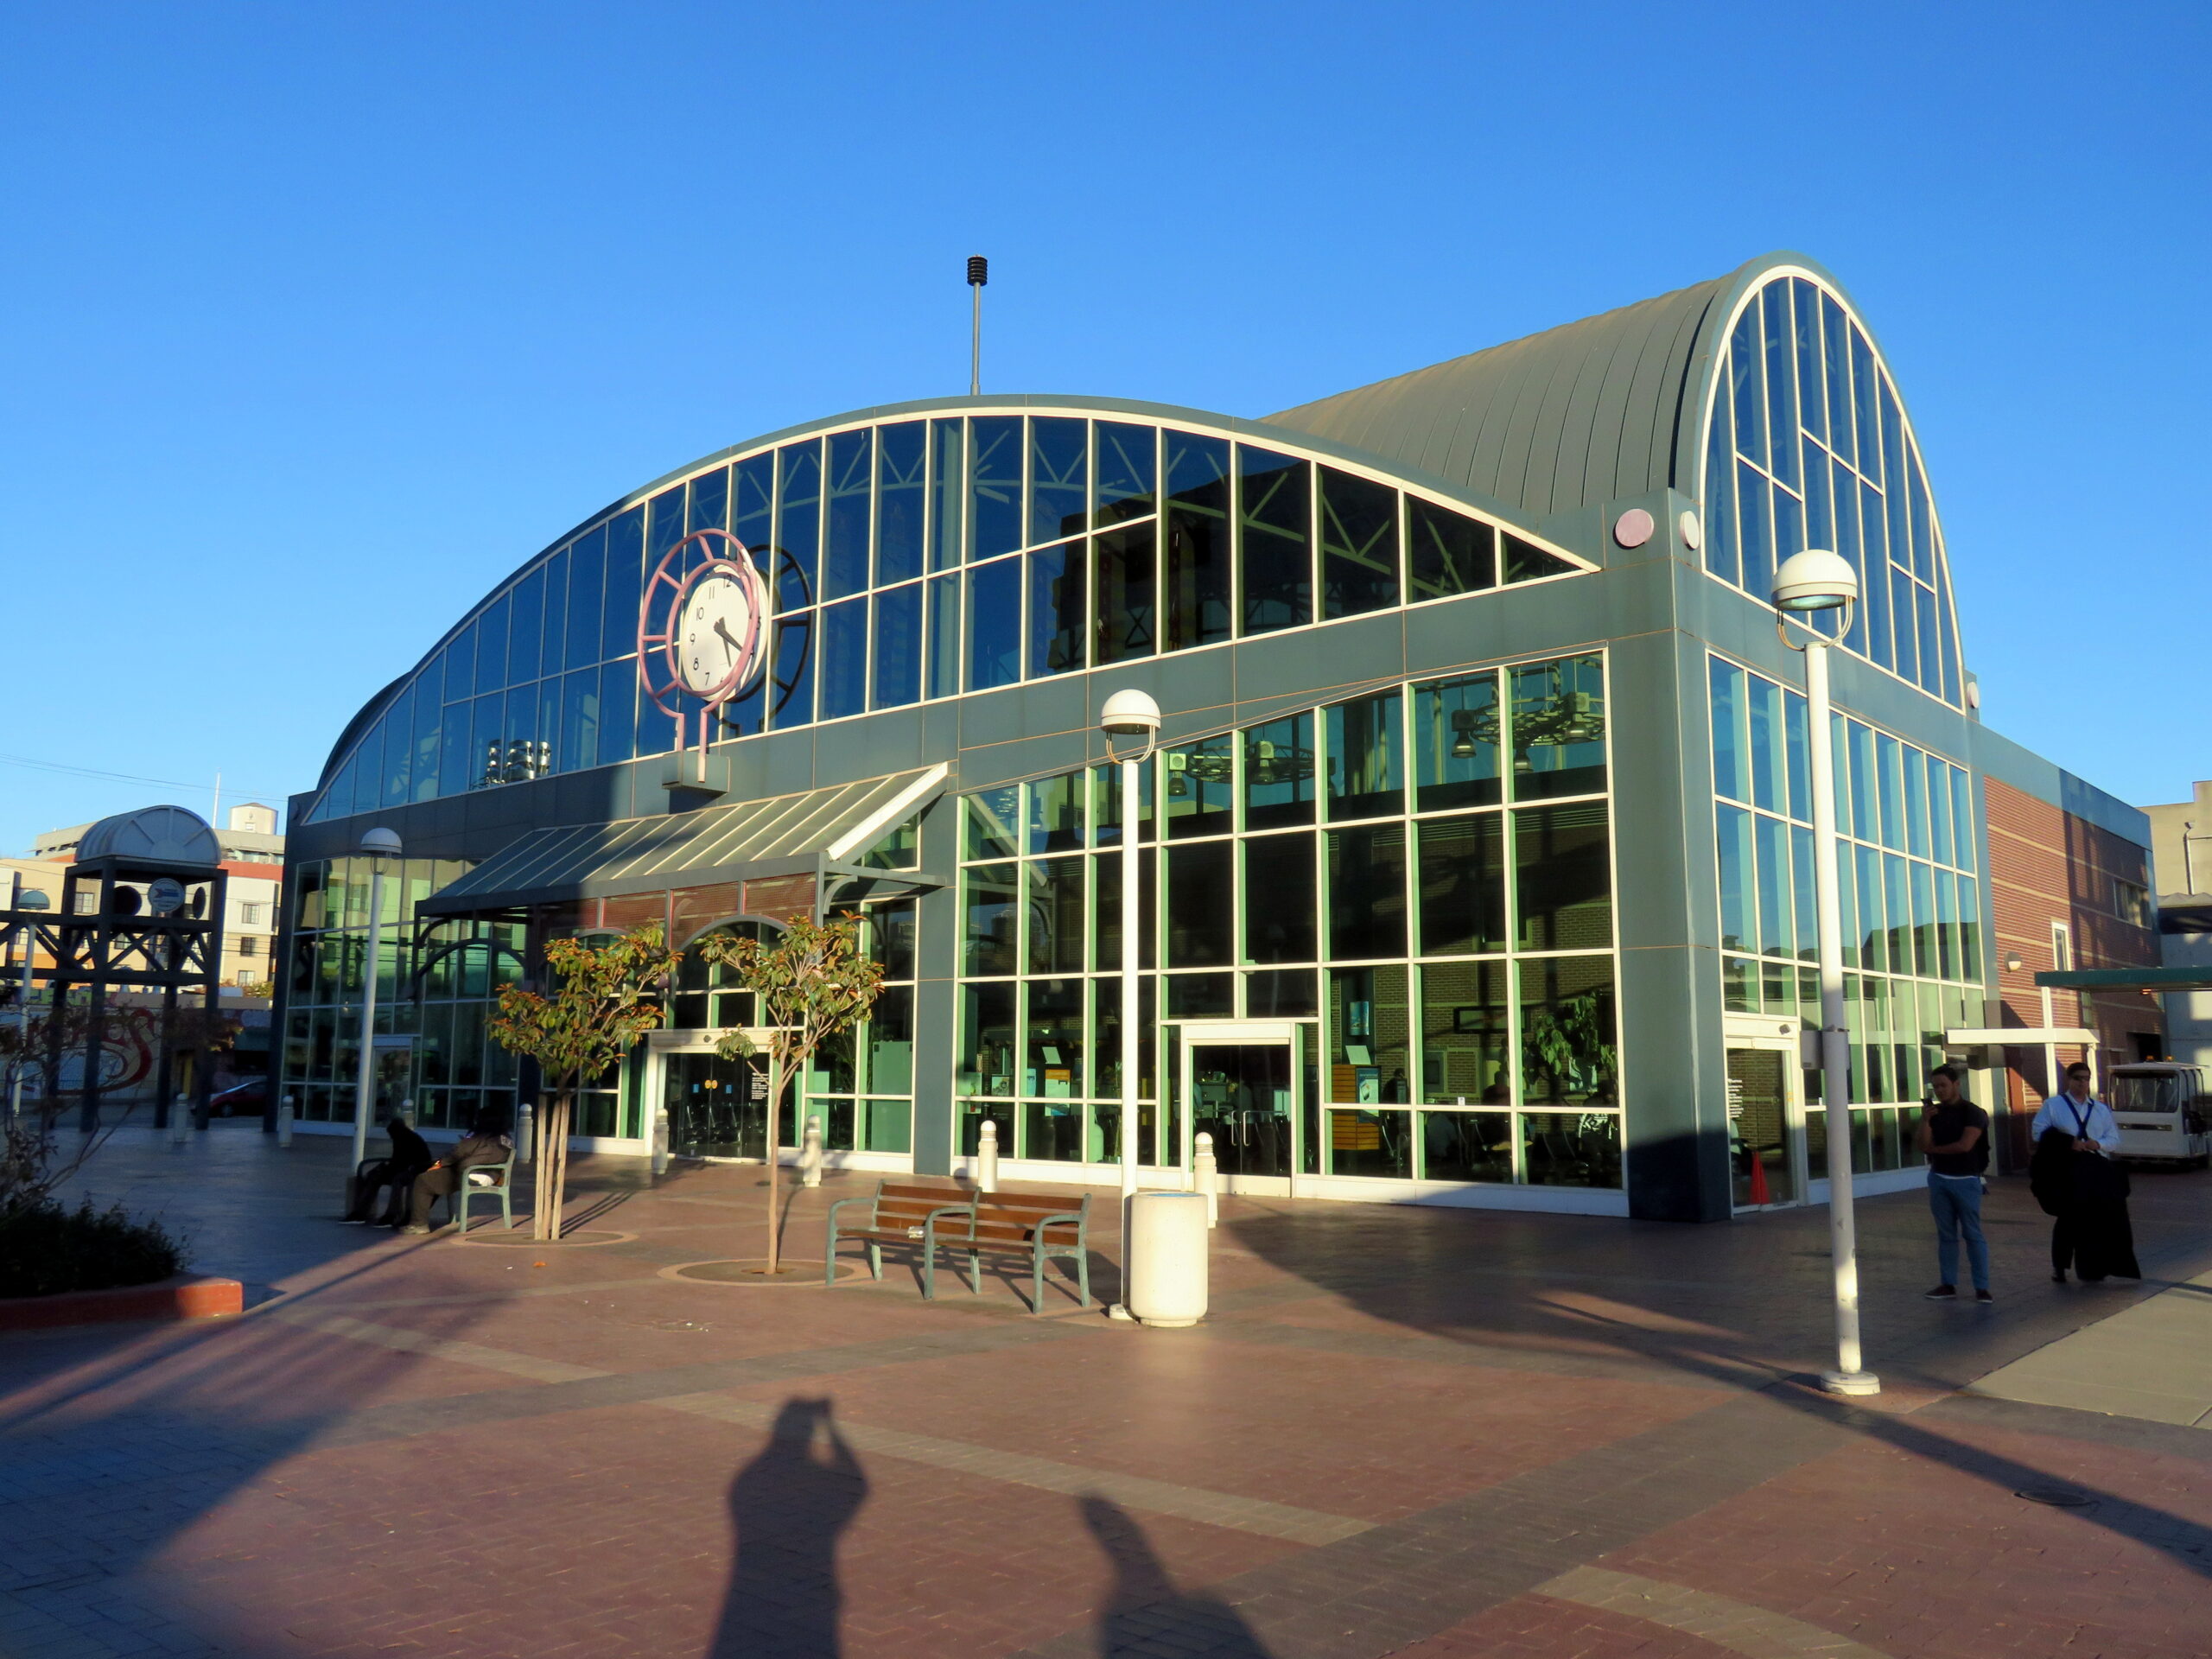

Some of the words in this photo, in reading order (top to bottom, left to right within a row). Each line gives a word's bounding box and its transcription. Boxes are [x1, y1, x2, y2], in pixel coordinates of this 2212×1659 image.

[723, 574, 732, 588] 12
[709, 586, 715, 600] 11
[696, 607, 704, 620] 10
[690, 632, 696, 645] 9
[693, 658, 699, 671] 8
[705, 671, 710, 686] 7
